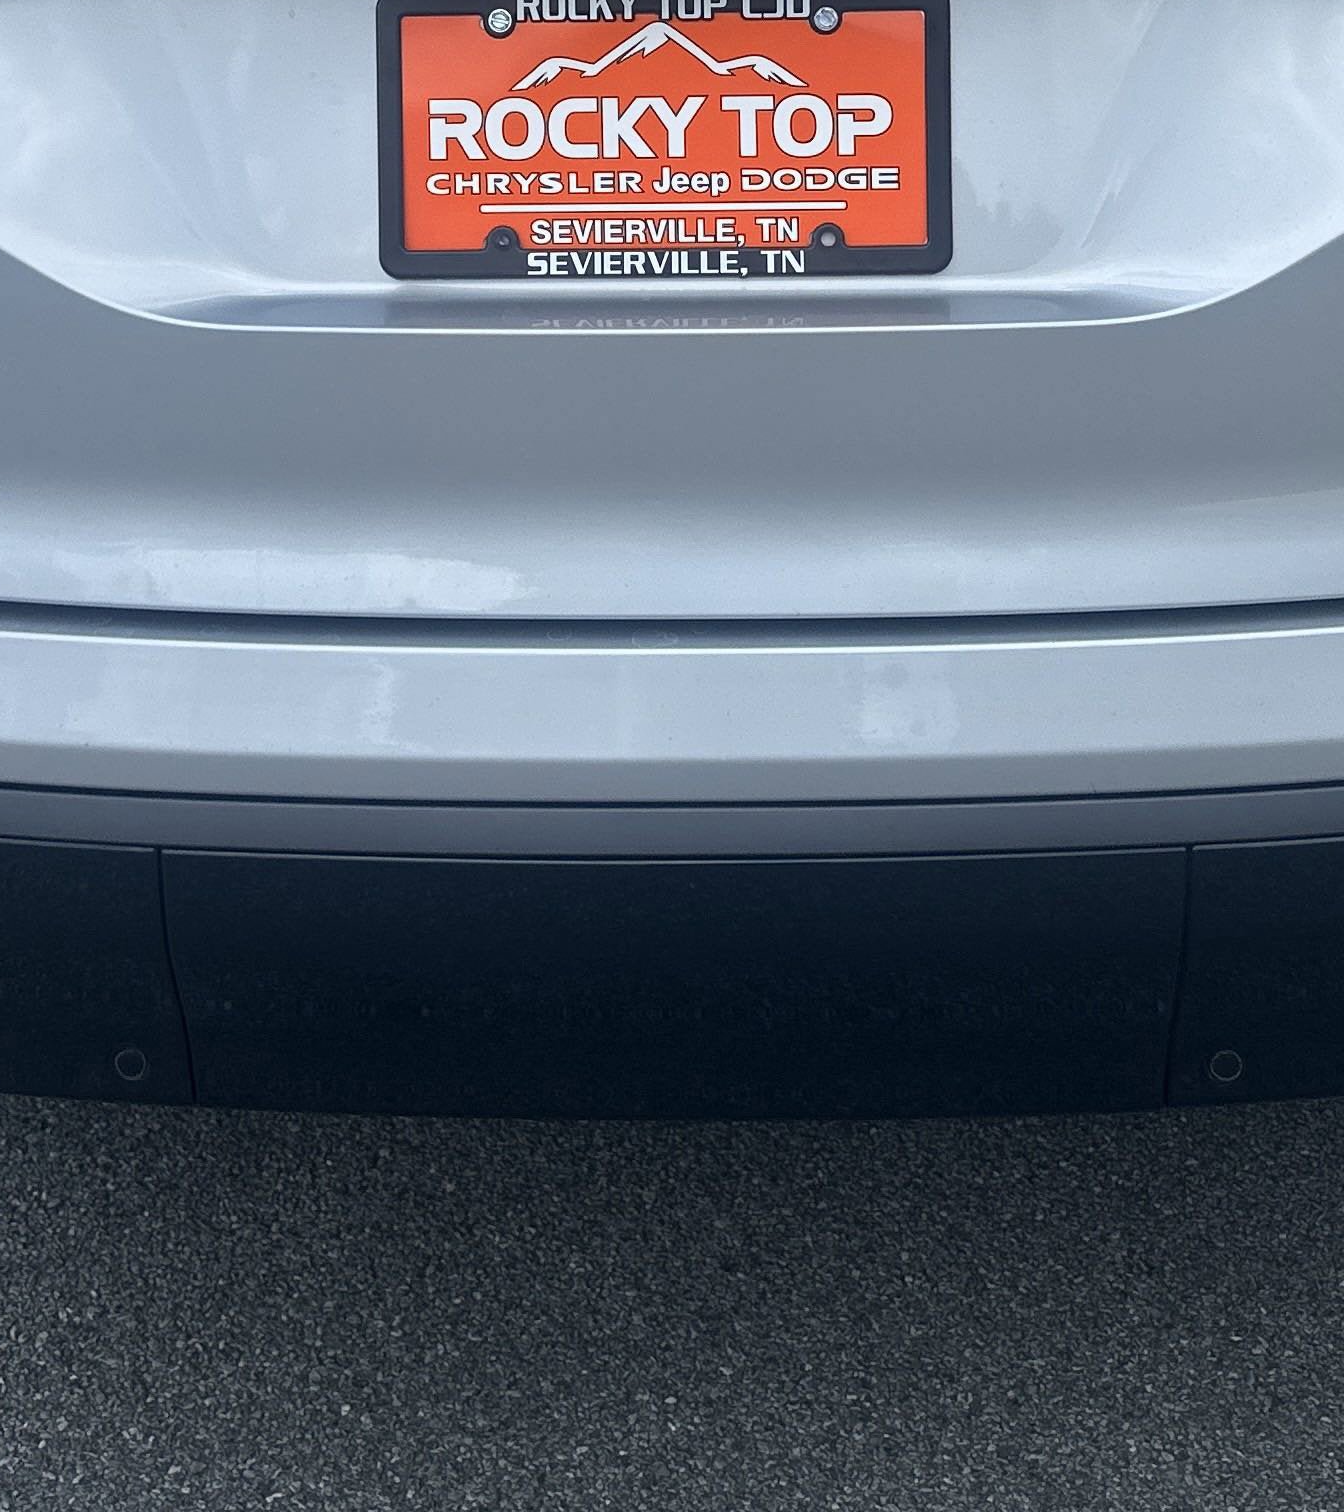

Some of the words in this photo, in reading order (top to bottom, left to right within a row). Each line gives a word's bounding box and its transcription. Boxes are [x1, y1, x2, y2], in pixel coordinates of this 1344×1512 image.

[428, 94, 710, 162] ROCKY
[720, 92, 895, 158] TOP
[425, 171, 644, 196] CHRYSLER
[652, 166, 731, 197] Jeep
[740, 166, 901, 192] DODGE
[529, 217, 746, 248] SEVIERVILLE,
[755, 217, 800, 244] TN
[527, 250, 749, 278] SEVIERVILLE,
[760, 249, 806, 274] TN
